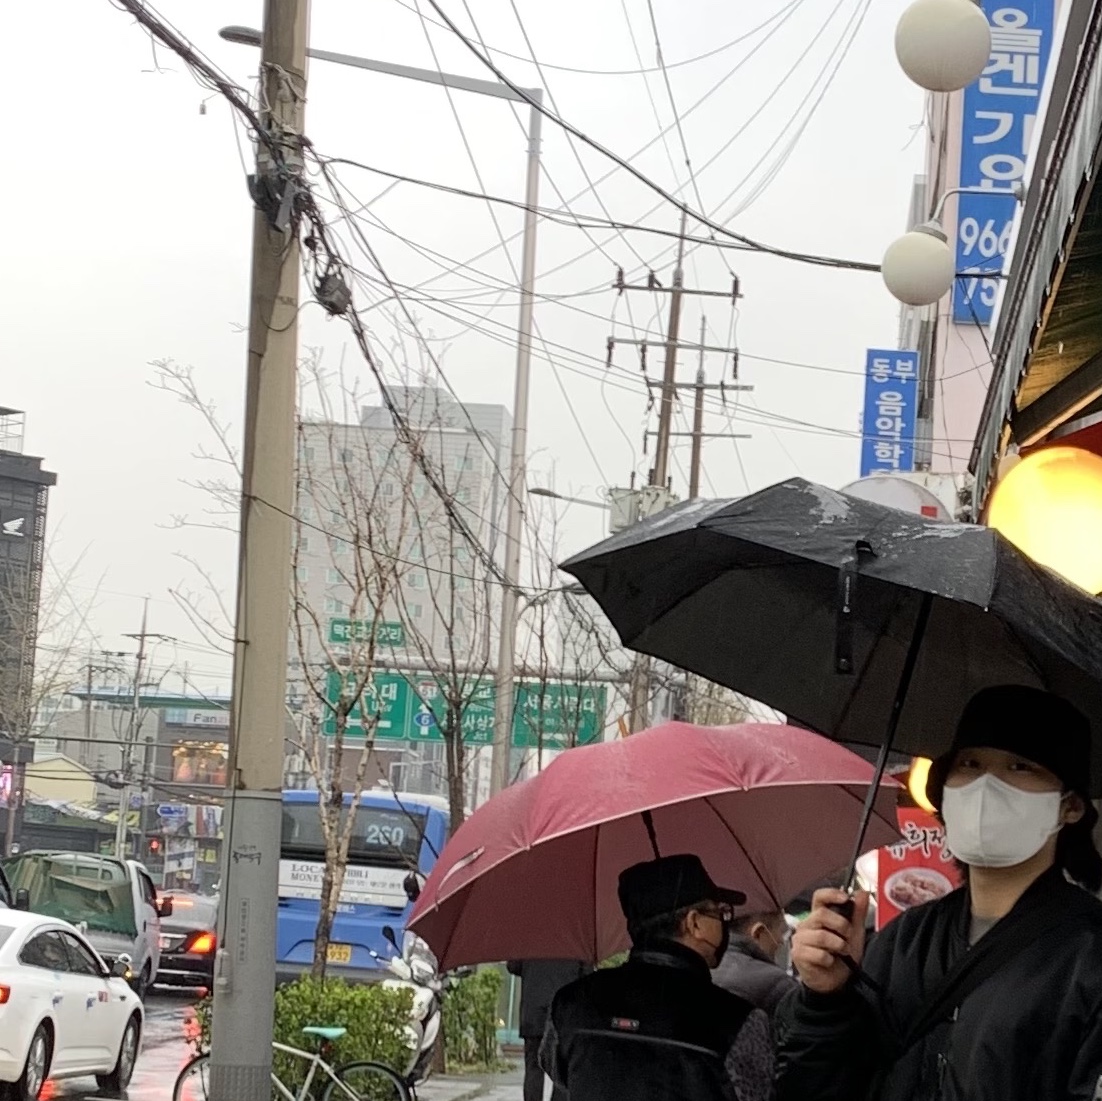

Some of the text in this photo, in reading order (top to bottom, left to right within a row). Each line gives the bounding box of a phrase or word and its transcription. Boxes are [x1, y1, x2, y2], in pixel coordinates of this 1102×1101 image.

[869, 357, 916, 385] 동부
[873, 390, 908, 475] 음악학
[421, 714, 429, 725] 6
[366, 824, 404, 846] 260
